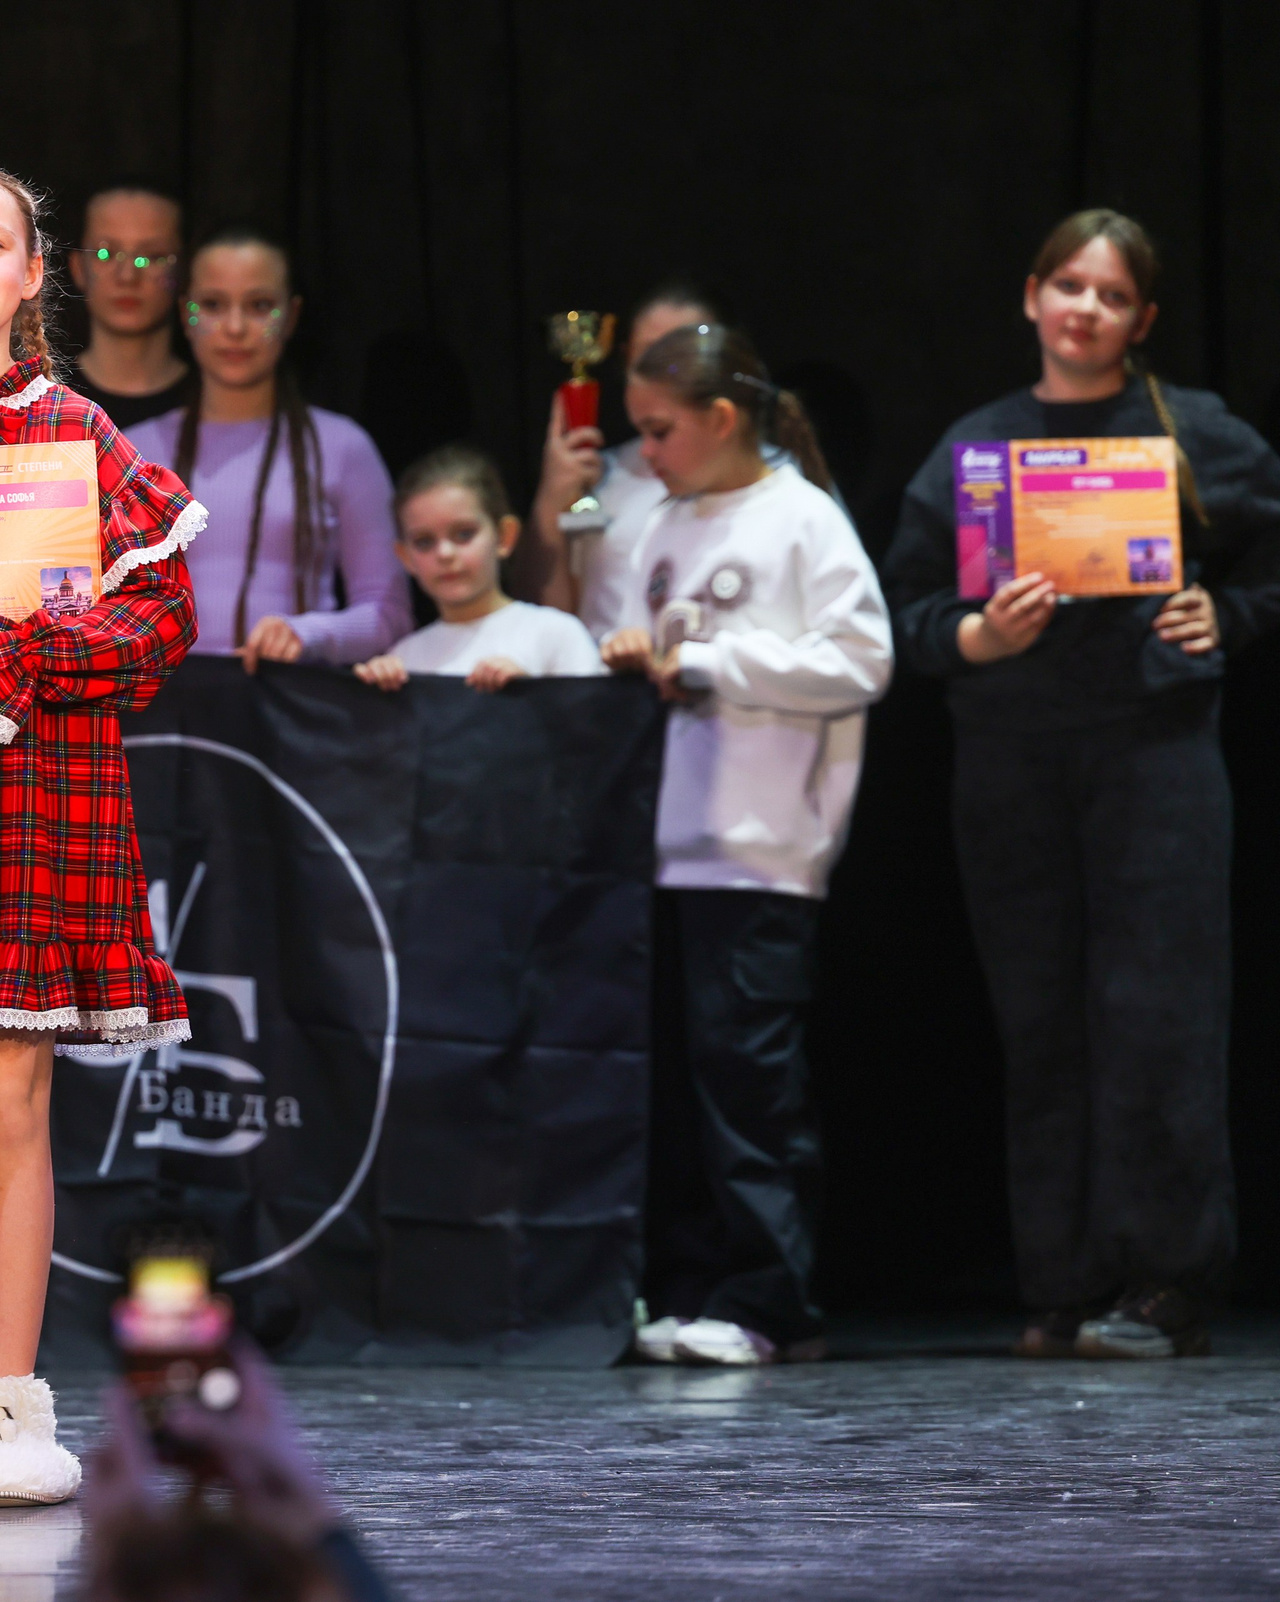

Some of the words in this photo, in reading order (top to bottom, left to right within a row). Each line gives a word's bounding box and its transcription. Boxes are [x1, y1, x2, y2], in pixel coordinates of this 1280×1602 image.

[17, 461, 63, 473] СТЕПЕНИ
[7, 492, 35, 503] СОФЬЯ
[136, 1069, 303, 1129] Банда
